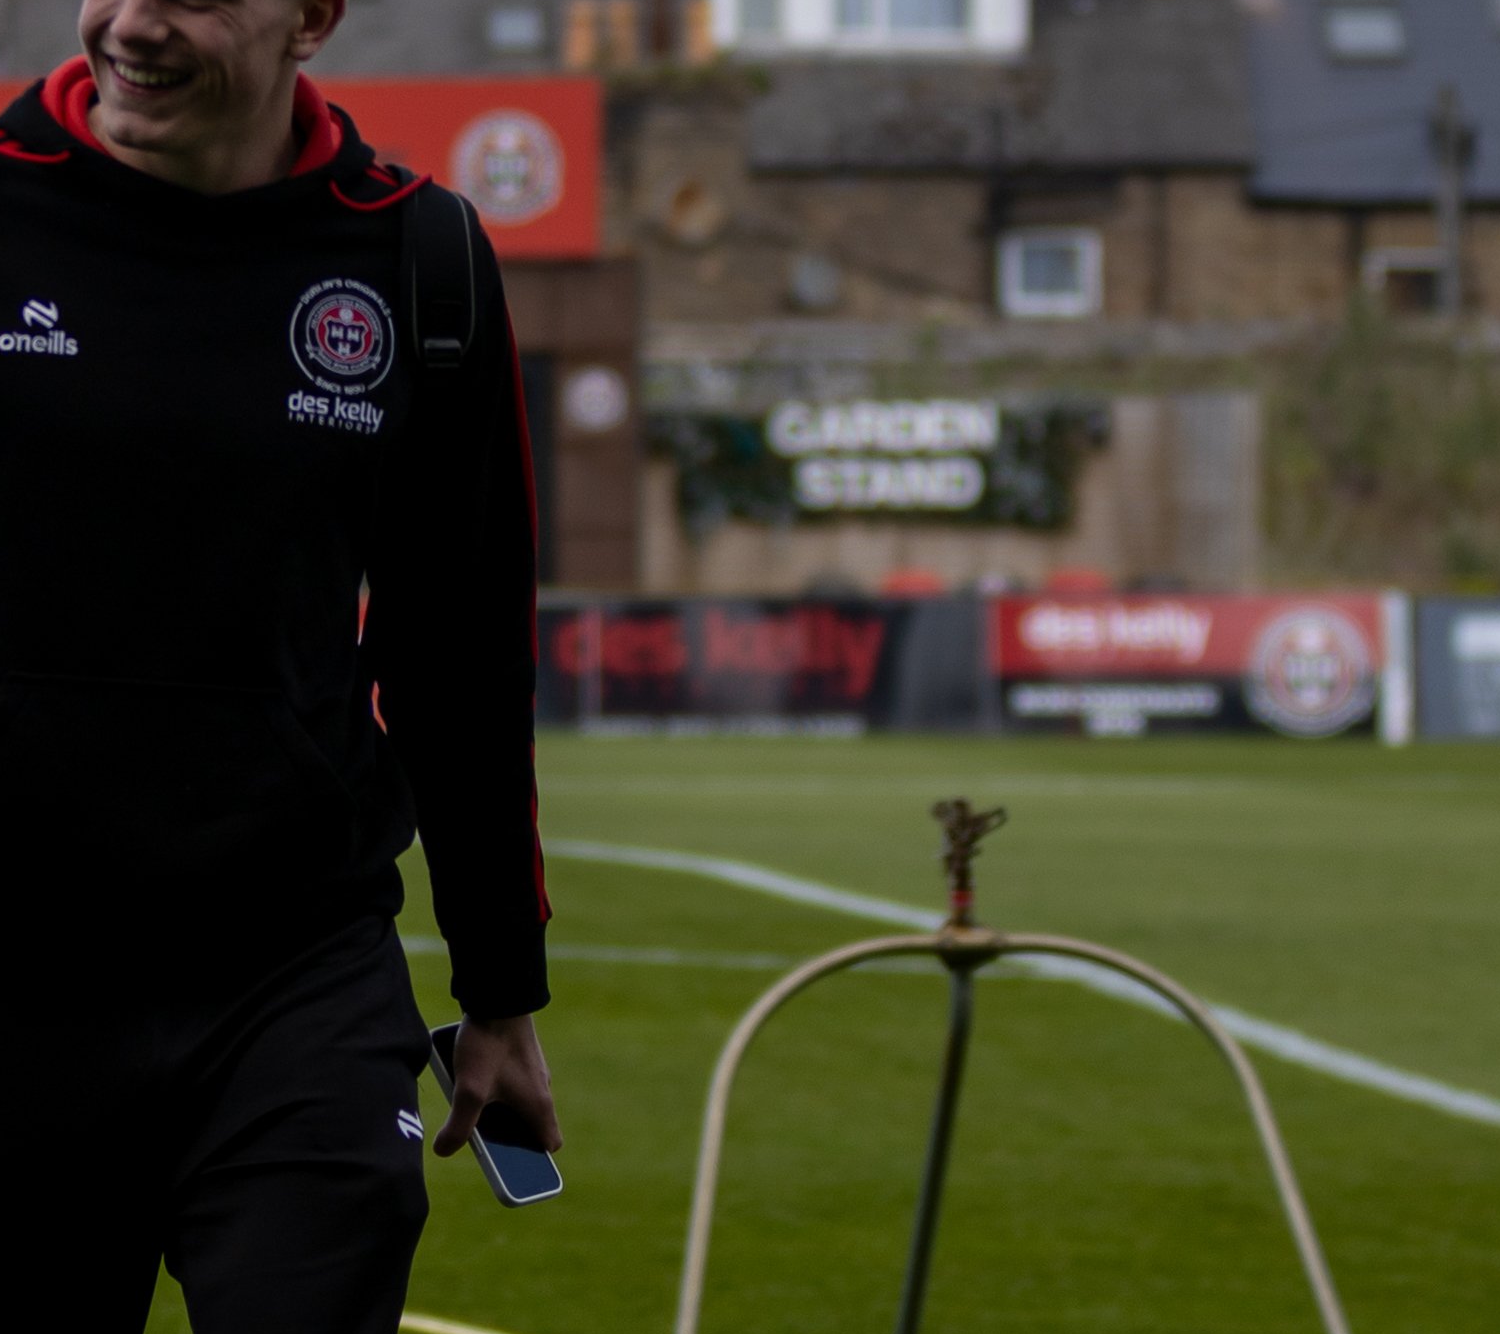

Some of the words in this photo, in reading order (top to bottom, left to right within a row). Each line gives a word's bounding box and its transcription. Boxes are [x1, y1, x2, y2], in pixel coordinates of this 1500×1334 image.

[287, 390, 330, 415] des
[334, 396, 385, 434] kelly
[288, 411, 374, 435] INTERIORS
[768, 400, 1000, 456] GARDEN
[795, 456, 986, 511] STAND
